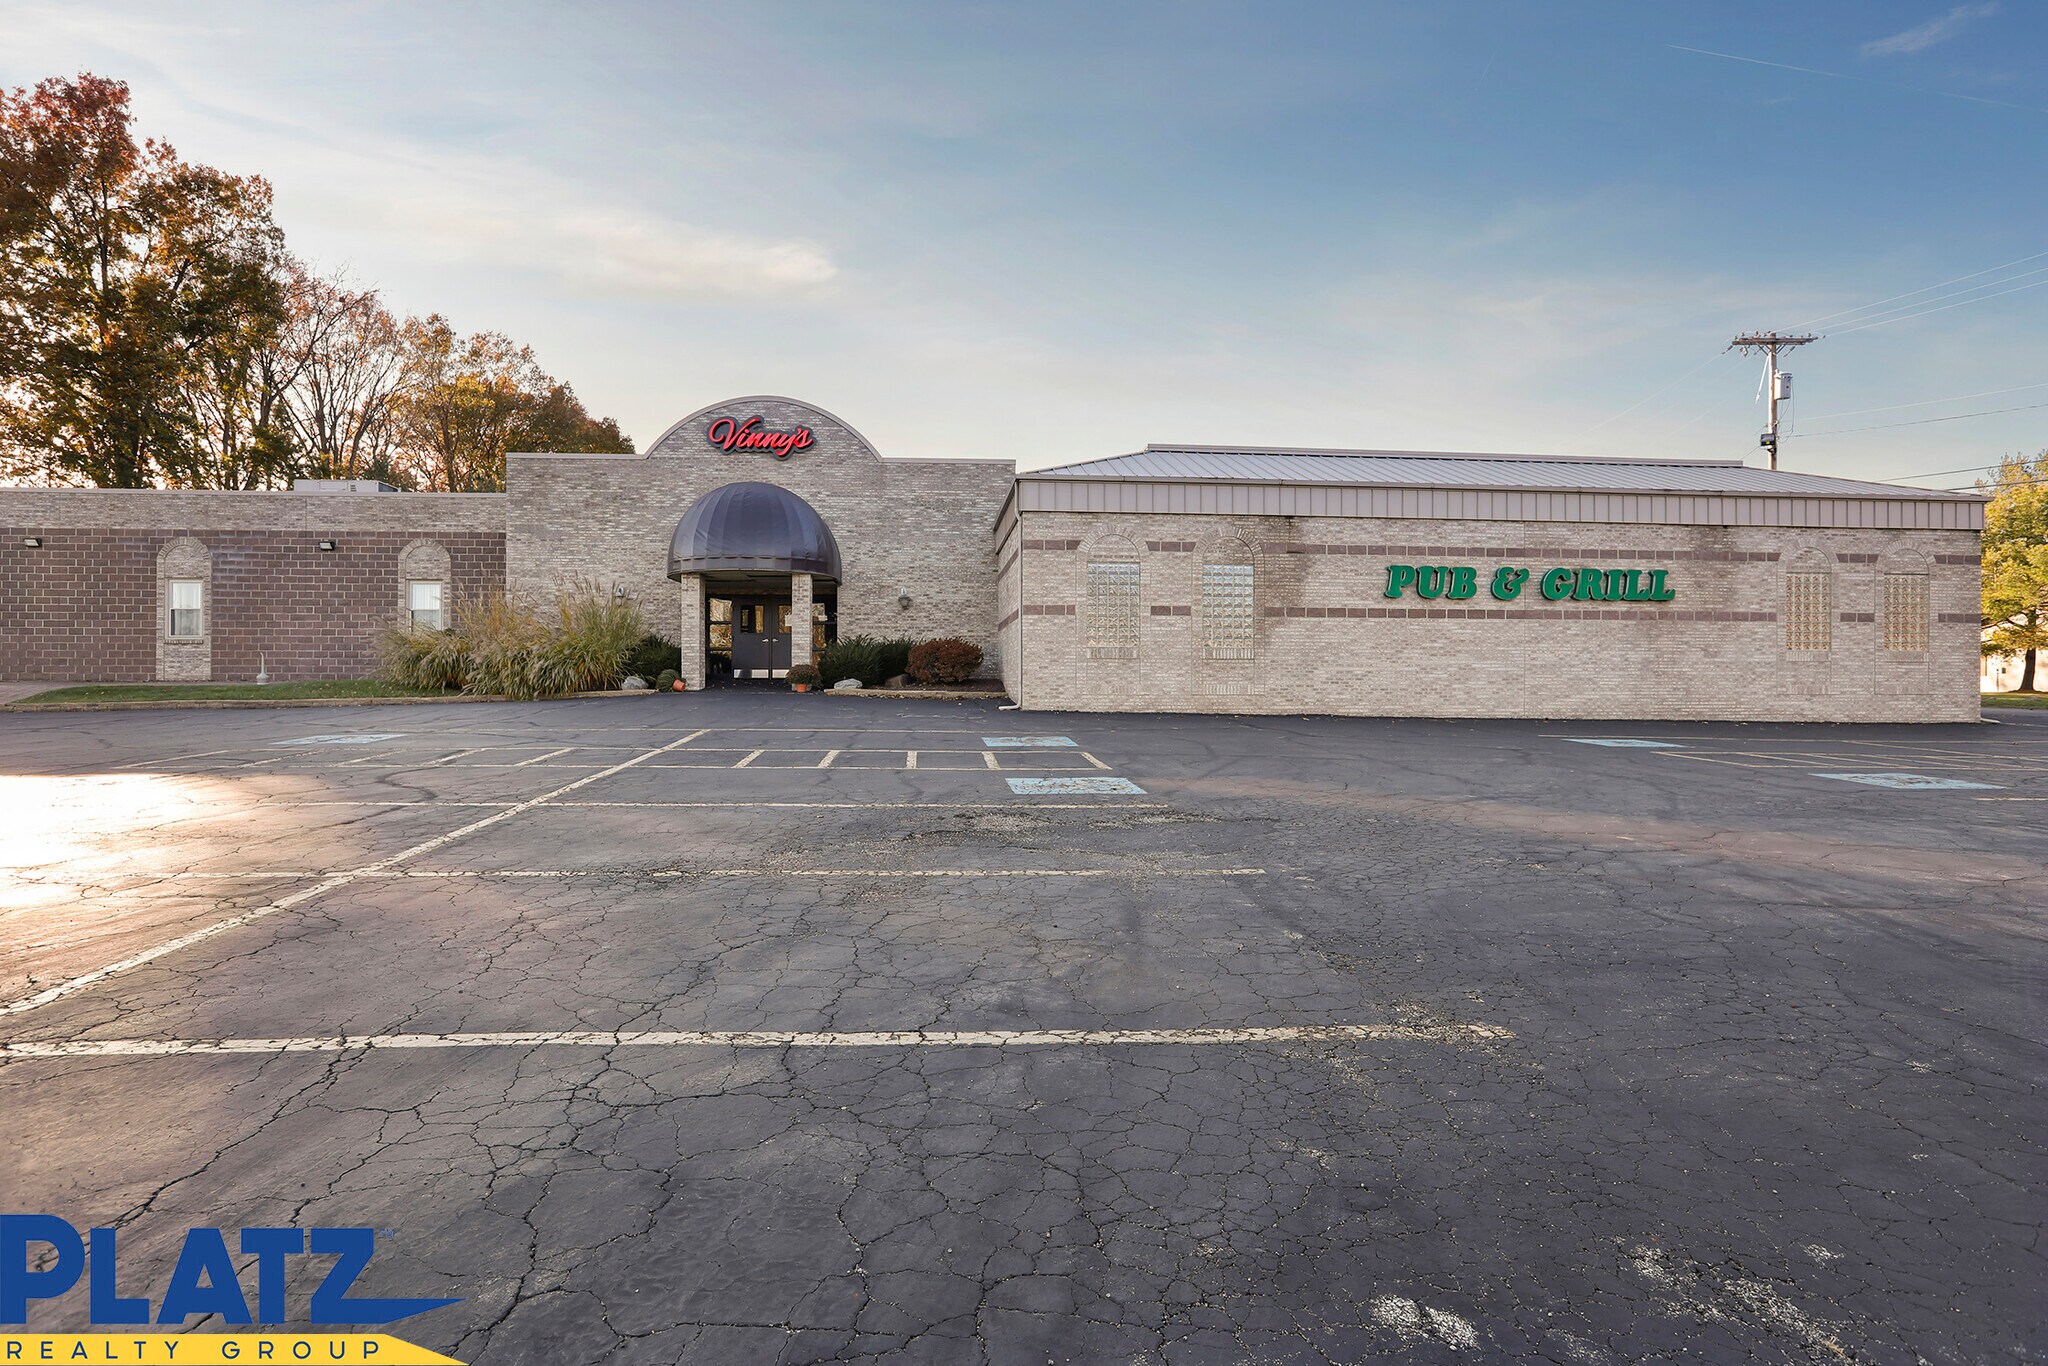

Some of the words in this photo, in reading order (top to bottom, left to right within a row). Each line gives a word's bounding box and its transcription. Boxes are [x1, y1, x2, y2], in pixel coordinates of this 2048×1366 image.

[708, 416, 813, 457] Vinny's
[1385, 565, 1477, 599] PUB
[1491, 567, 1530, 601] &
[1542, 568, 1676, 601] GRILL
